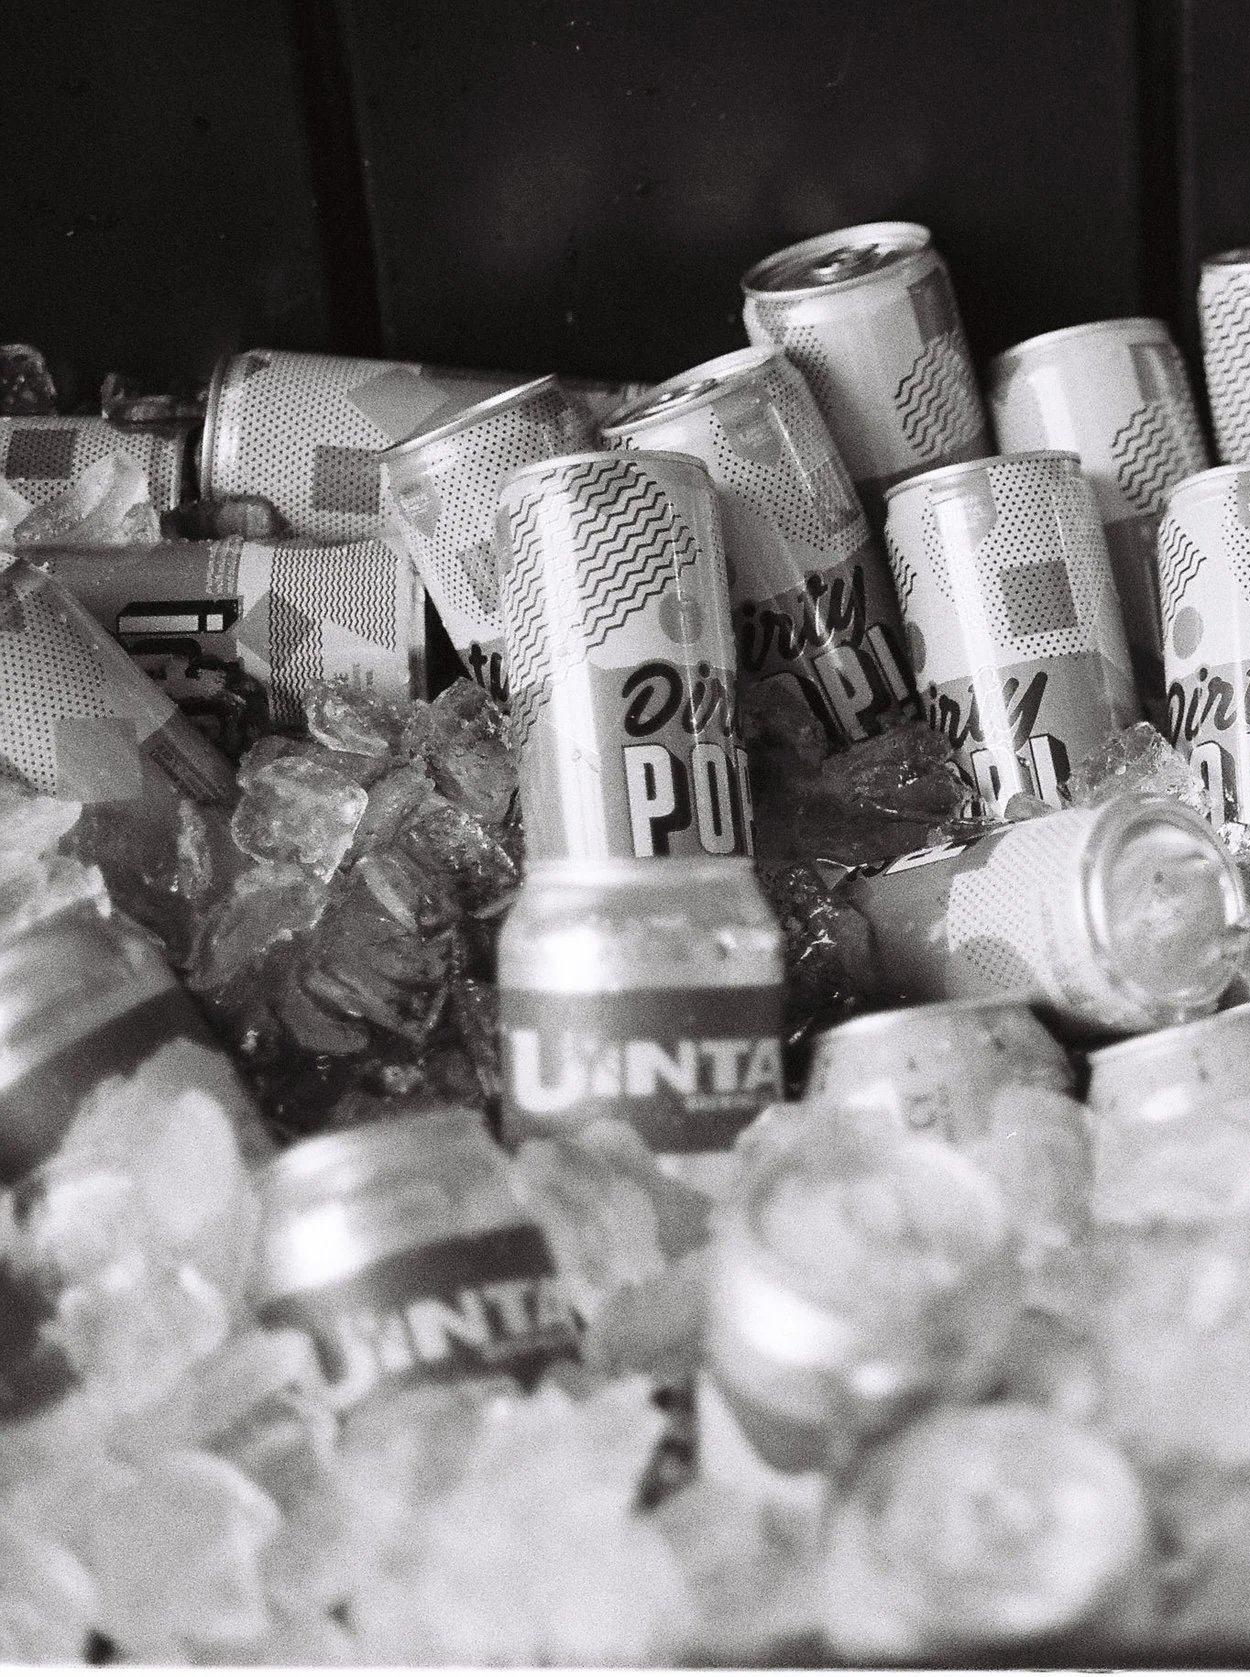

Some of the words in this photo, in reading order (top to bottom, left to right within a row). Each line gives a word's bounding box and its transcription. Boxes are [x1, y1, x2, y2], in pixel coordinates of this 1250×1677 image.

[740, 565, 866, 672] irty
[929, 672, 1048, 750] irty
[510, 1029, 784, 1112] UINTA
